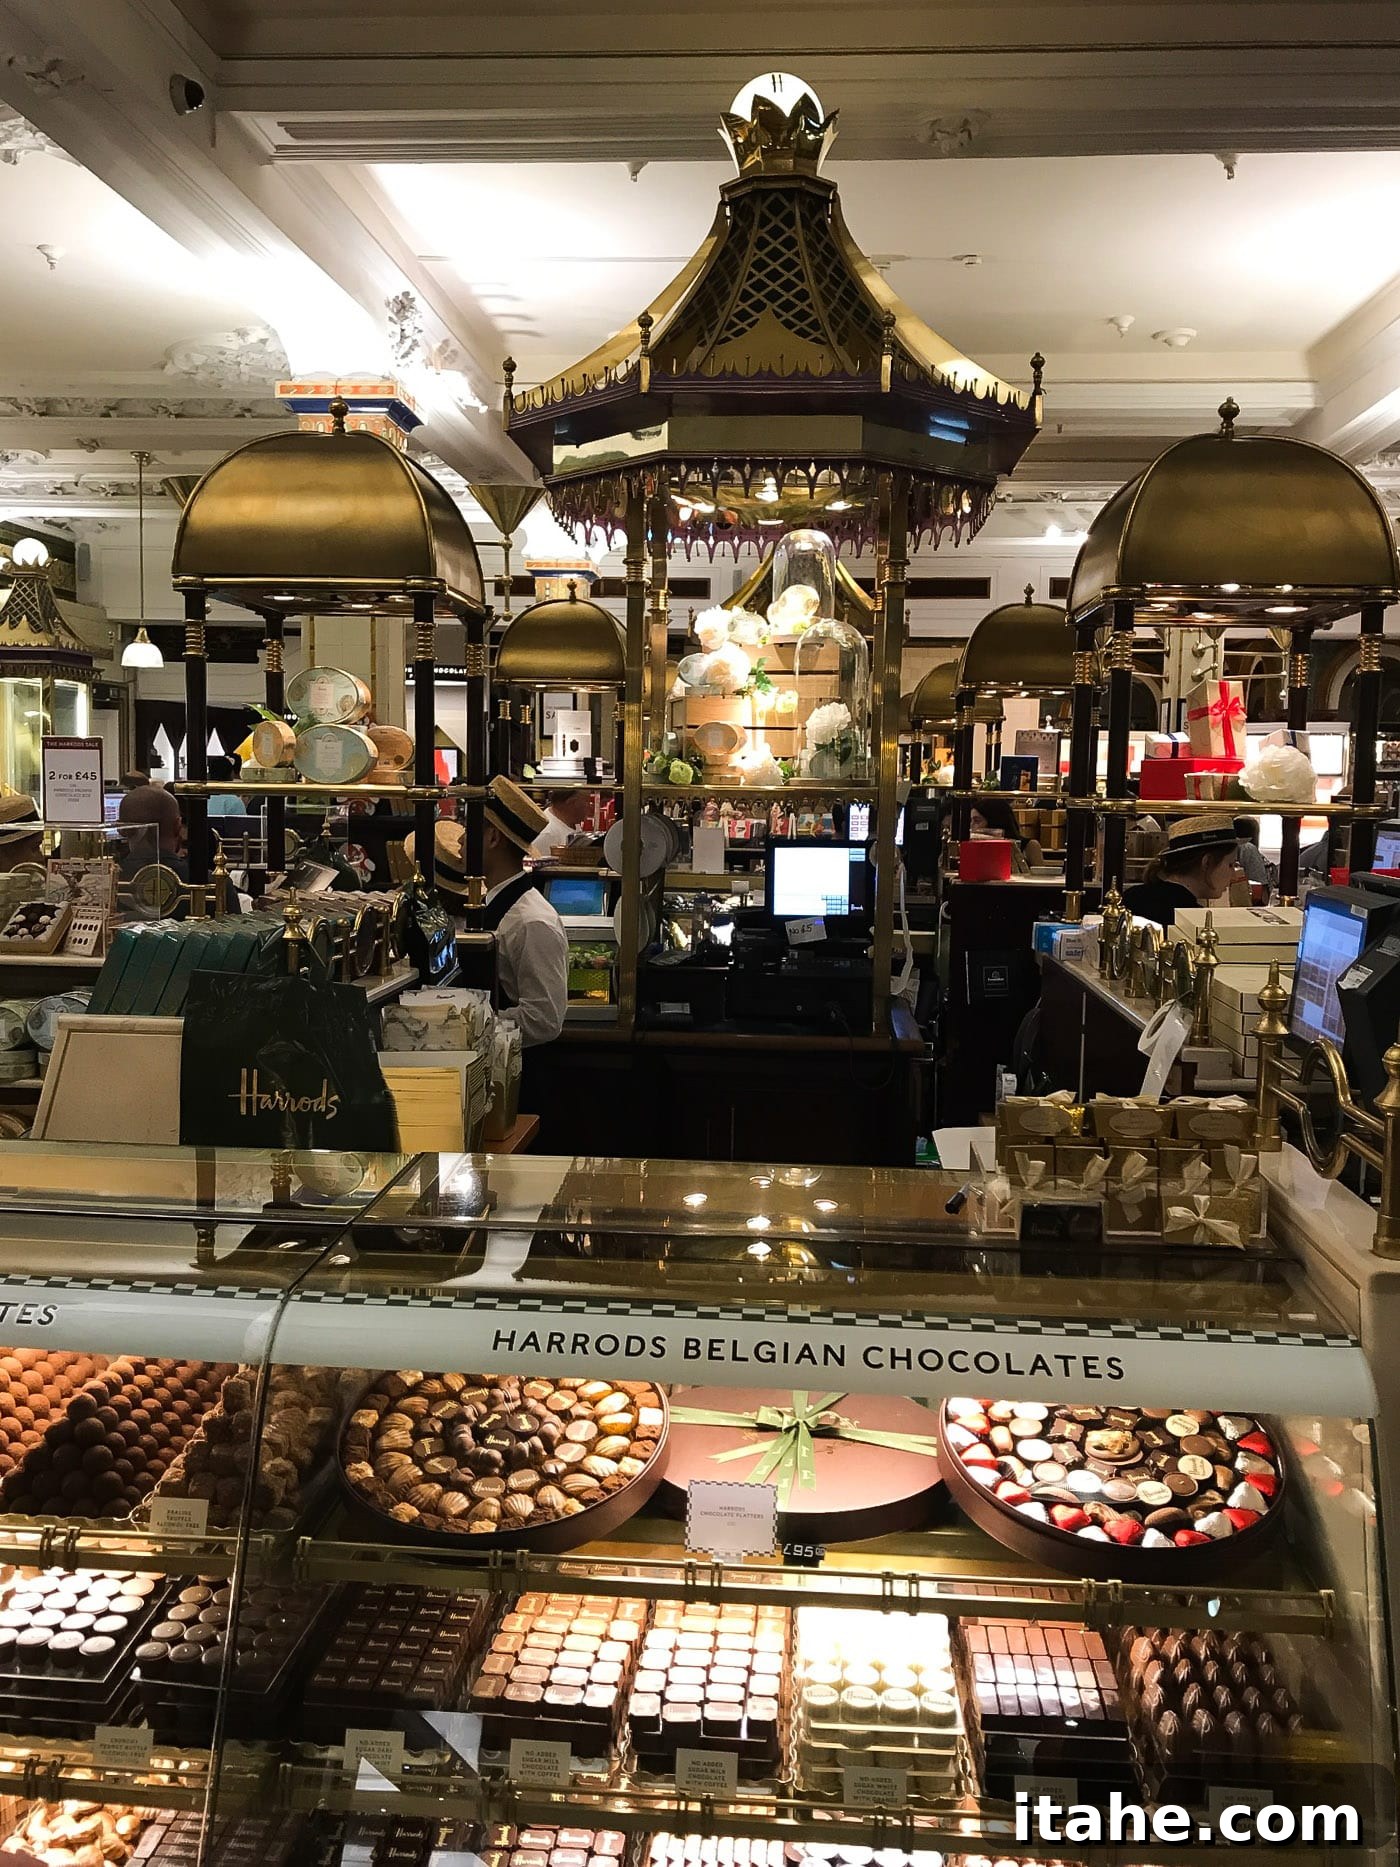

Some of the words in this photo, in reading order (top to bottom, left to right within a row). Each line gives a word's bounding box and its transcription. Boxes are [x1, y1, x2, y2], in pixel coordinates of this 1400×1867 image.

[48, 771, 56, 780] 2
[75, 771, 97, 781] £45
[228, 1068, 341, 1120] Harrods
[492, 1329, 666, 1358] HARRODS
[683, 1337, 846, 1369] BELGIAN
[862, 1344, 1126, 1380] CHOCOLATES
[688, 1773, 725, 1781] CHOCOLATE
[395, 1828, 424, 1838] Harrods
